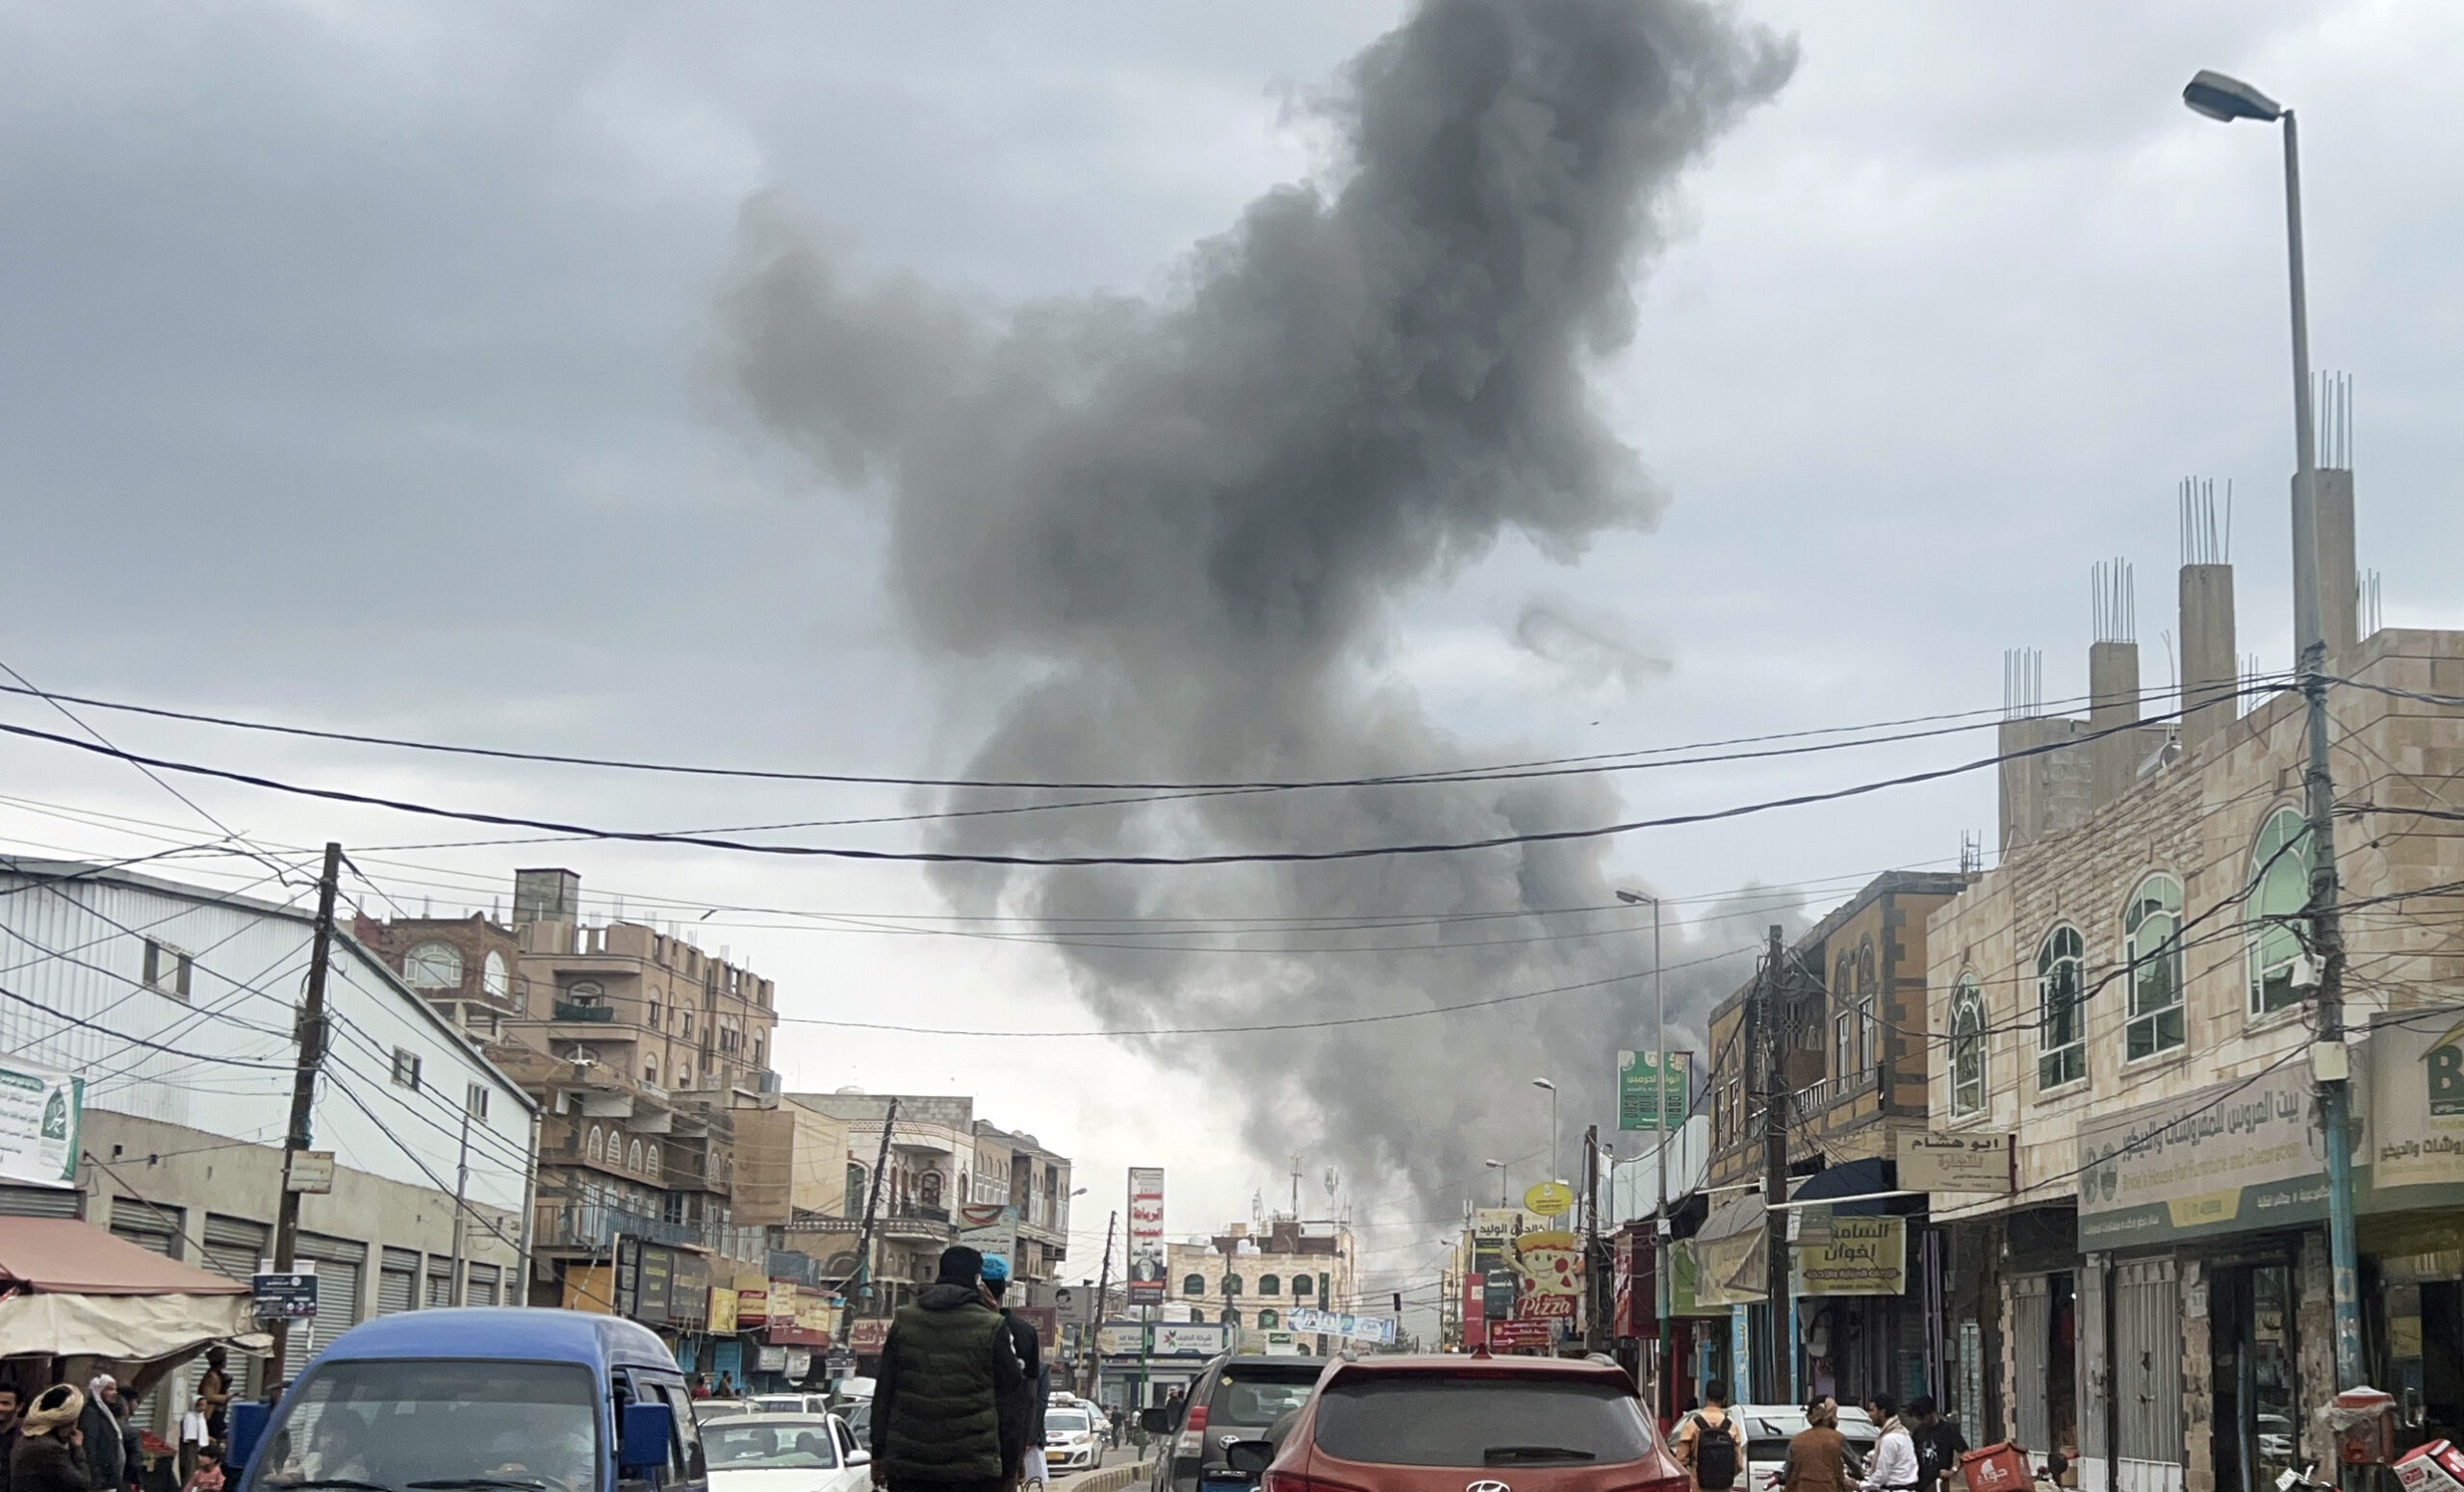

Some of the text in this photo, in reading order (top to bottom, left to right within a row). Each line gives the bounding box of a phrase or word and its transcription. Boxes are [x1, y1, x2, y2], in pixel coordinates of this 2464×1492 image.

[2276, 1091, 2299, 1123] بيت
[1479, 1223, 1507, 1236] الوليد
[1521, 1298, 1572, 1316] Pizza
